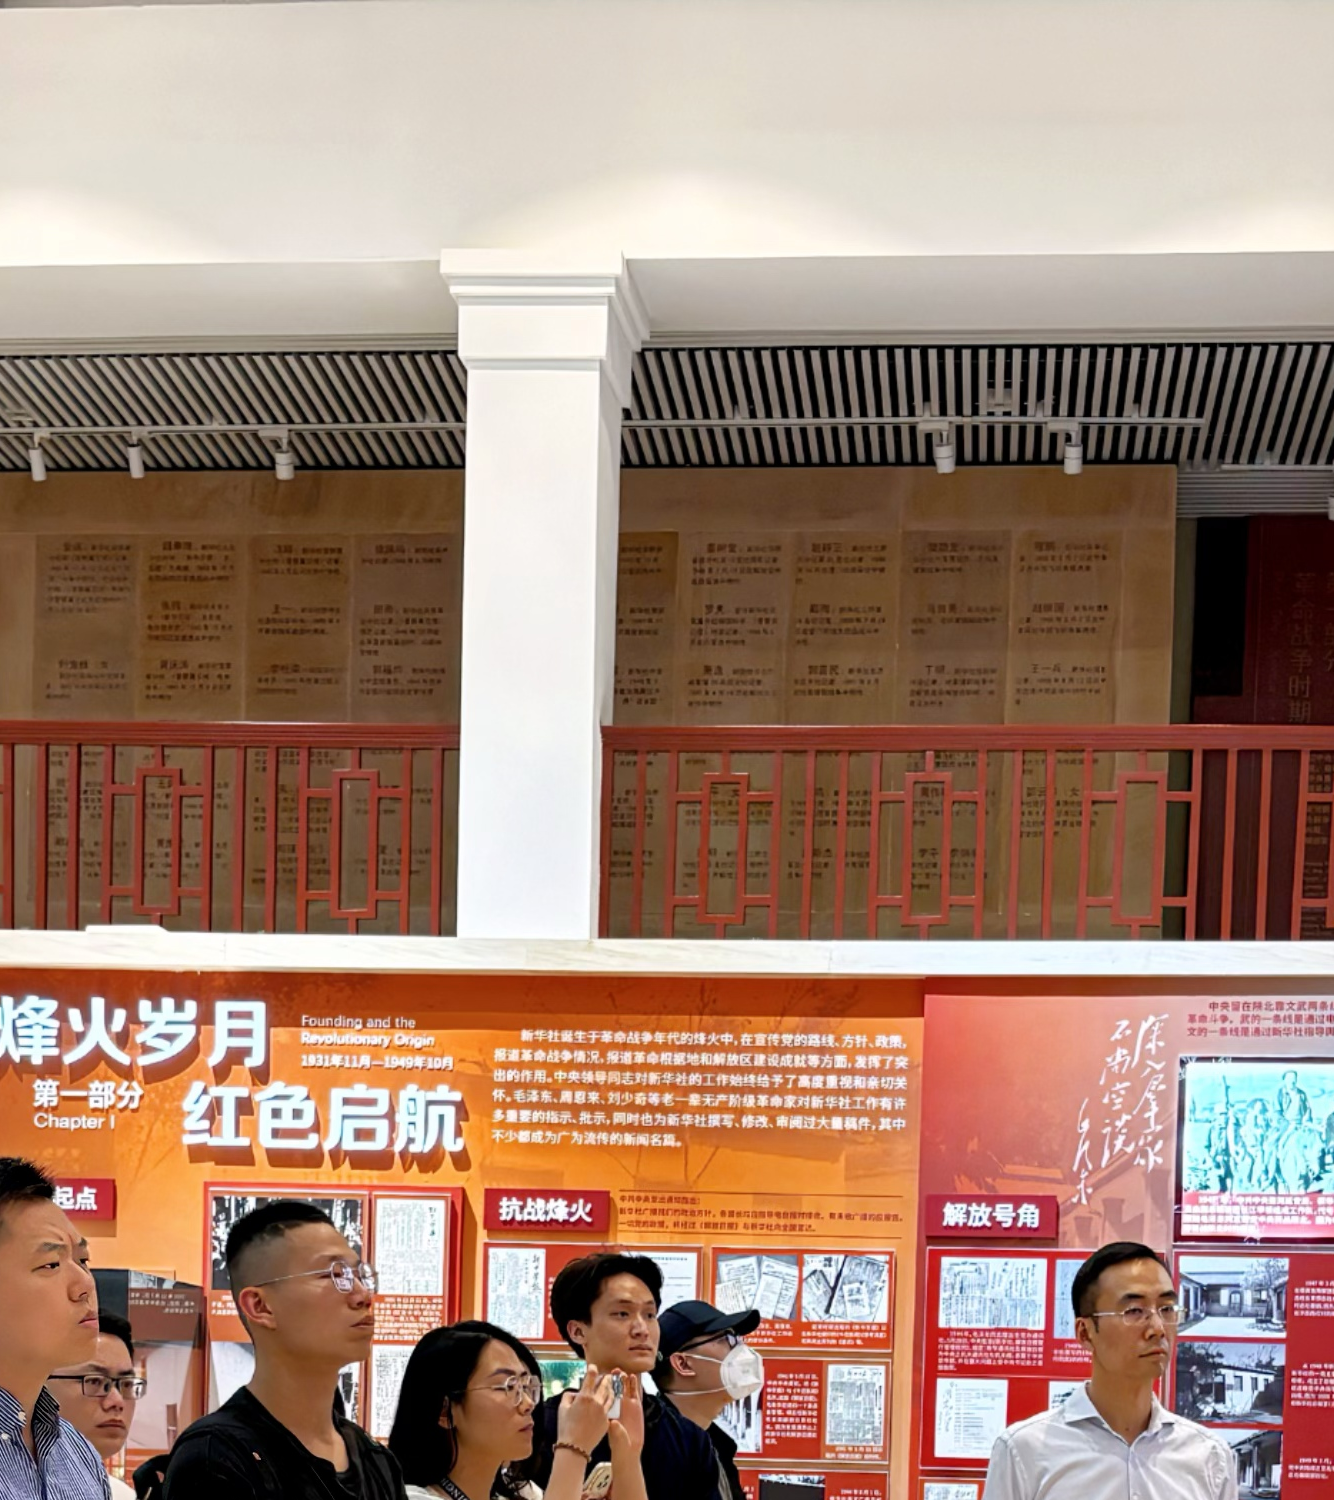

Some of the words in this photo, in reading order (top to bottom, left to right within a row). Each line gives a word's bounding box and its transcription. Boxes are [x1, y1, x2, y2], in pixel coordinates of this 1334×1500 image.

[301, 1015, 362, 1030] Founding
[366, 1016, 391, 1028] and
[395, 1016, 416, 1028] the
[301, 1031, 391, 1047] Revolutionary
[394, 1034, 435, 1048] Origin
[301, 1055, 453, 1071] 1931年11月—1949年10月
[33, 1079, 144, 1109] 第一部分
[34, 1112, 105, 1131] Chapter
[182, 1081, 464, 1153] 红色启航
[52, 1187, 98, 1212] 起点
[499, 1197, 593, 1224] 抗战烽火
[942, 1202, 1040, 1228] 解放号角
